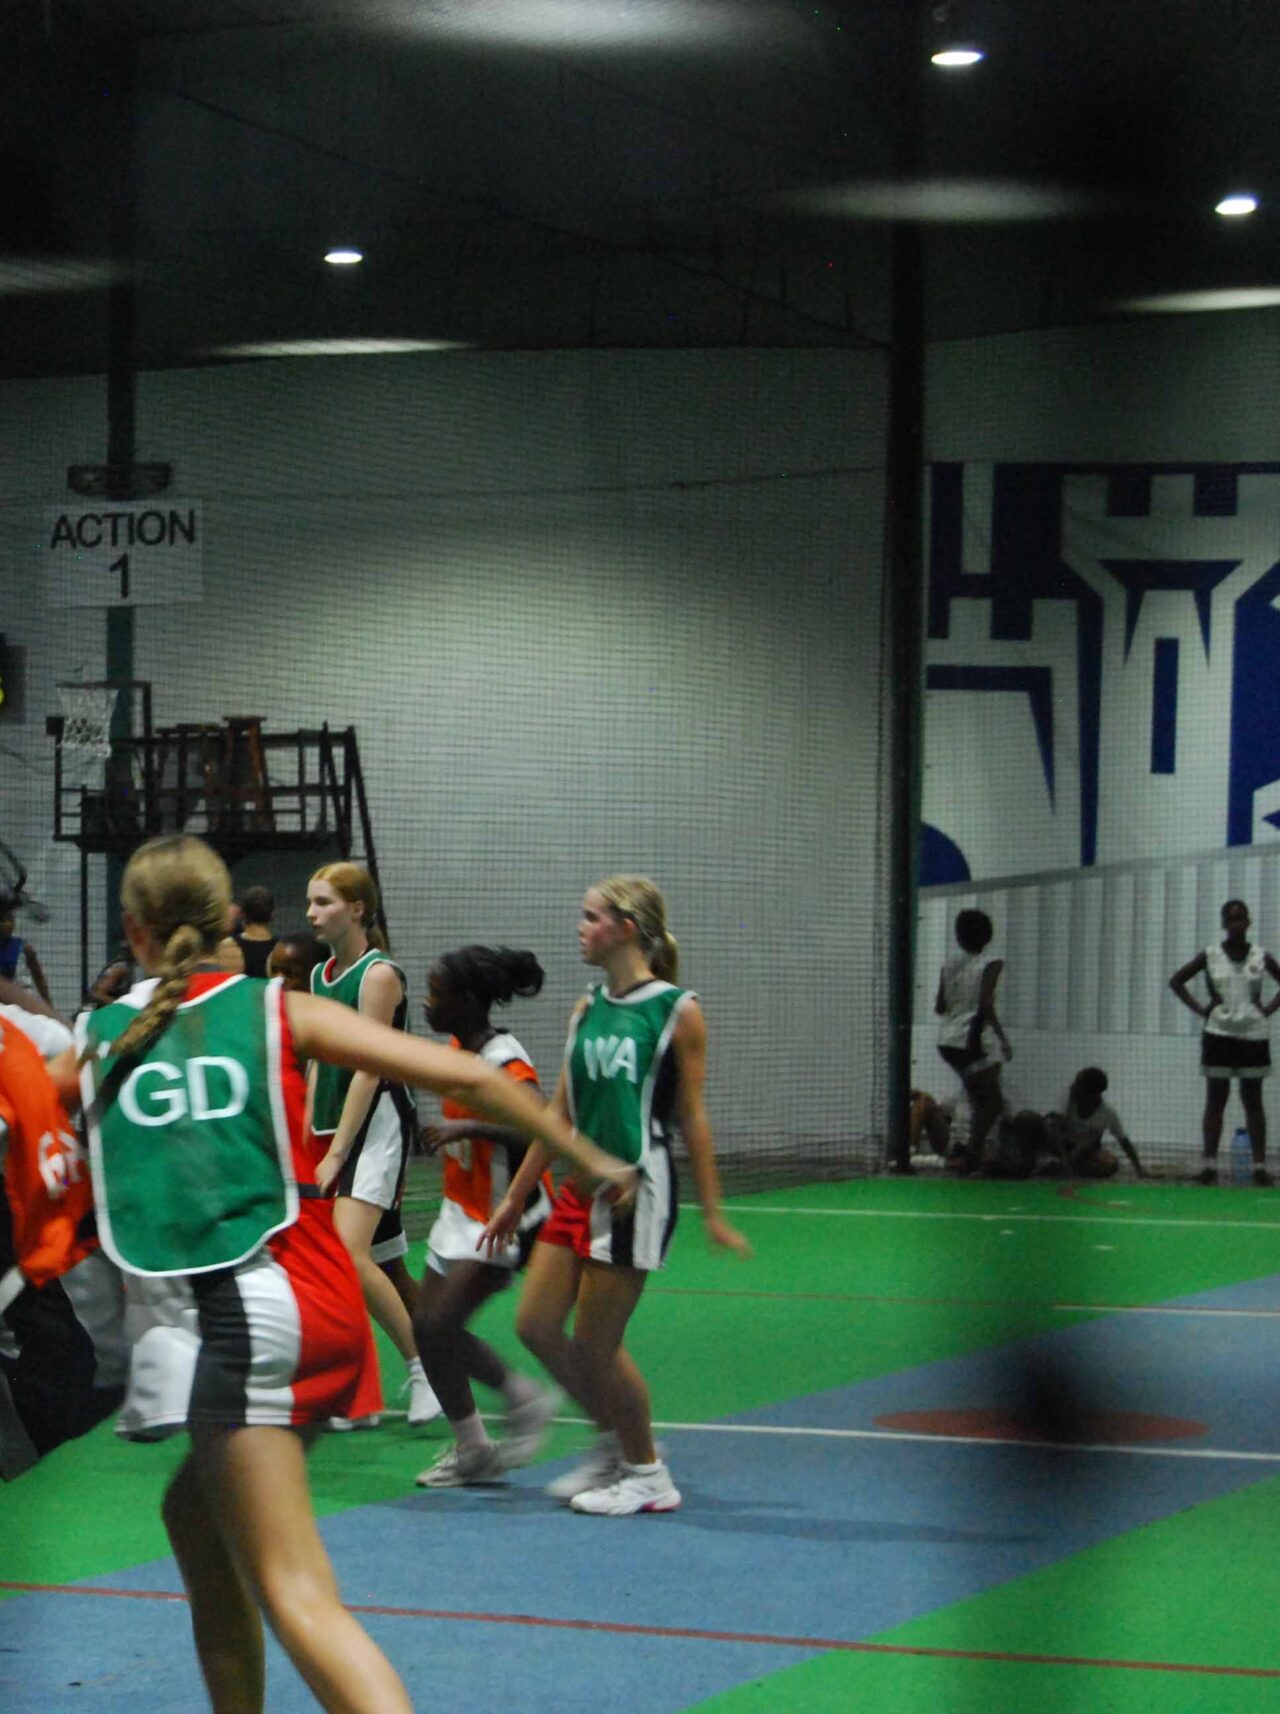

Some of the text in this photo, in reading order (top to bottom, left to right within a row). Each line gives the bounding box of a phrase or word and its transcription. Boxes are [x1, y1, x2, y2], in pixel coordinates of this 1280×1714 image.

[50, 509, 195, 549] ACTION
[109, 552, 129, 598] 1
[583, 1035, 638, 1084] WA
[118, 1056, 250, 1127] GD
